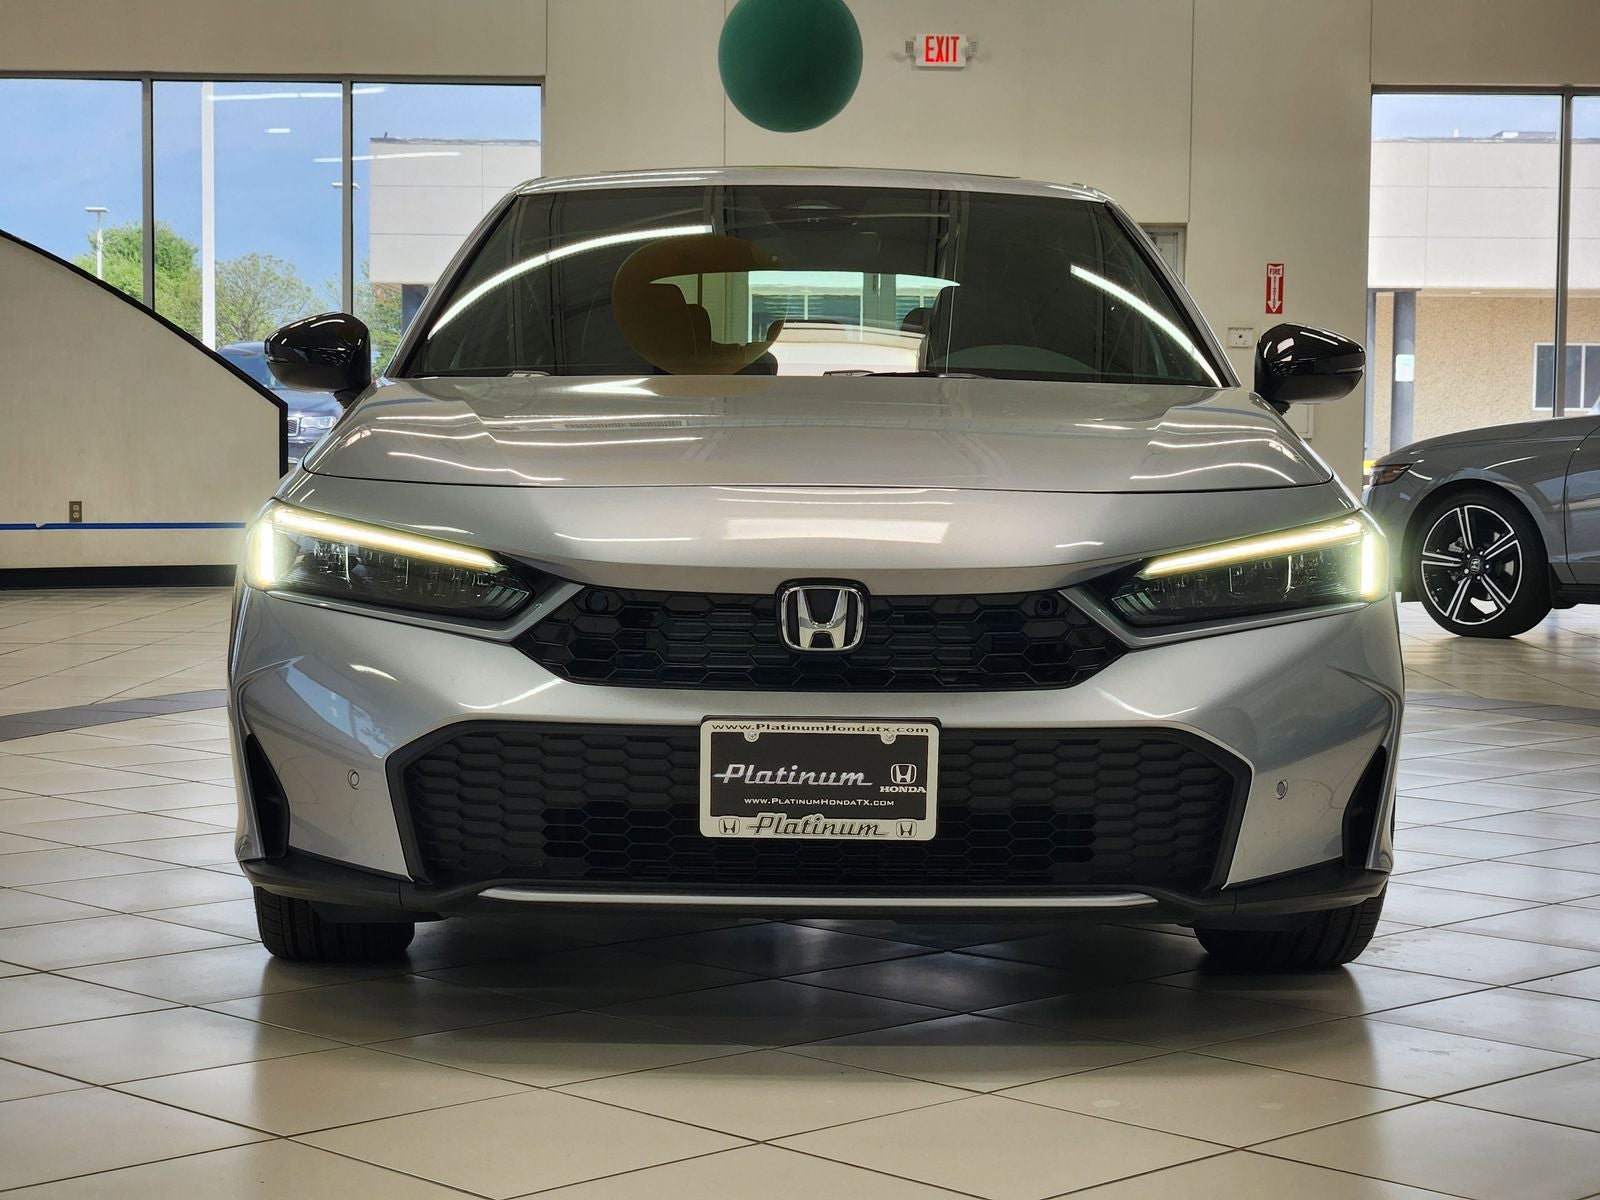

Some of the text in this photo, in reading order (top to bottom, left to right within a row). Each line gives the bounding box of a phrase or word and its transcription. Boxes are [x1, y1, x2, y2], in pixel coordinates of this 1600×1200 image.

[925, 35, 960, 62] EXIT
[712, 723, 929, 733] www.PlatinumHondatx.com
[713, 763, 873, 786] Platinum
[747, 816, 889, 836] Platinum
